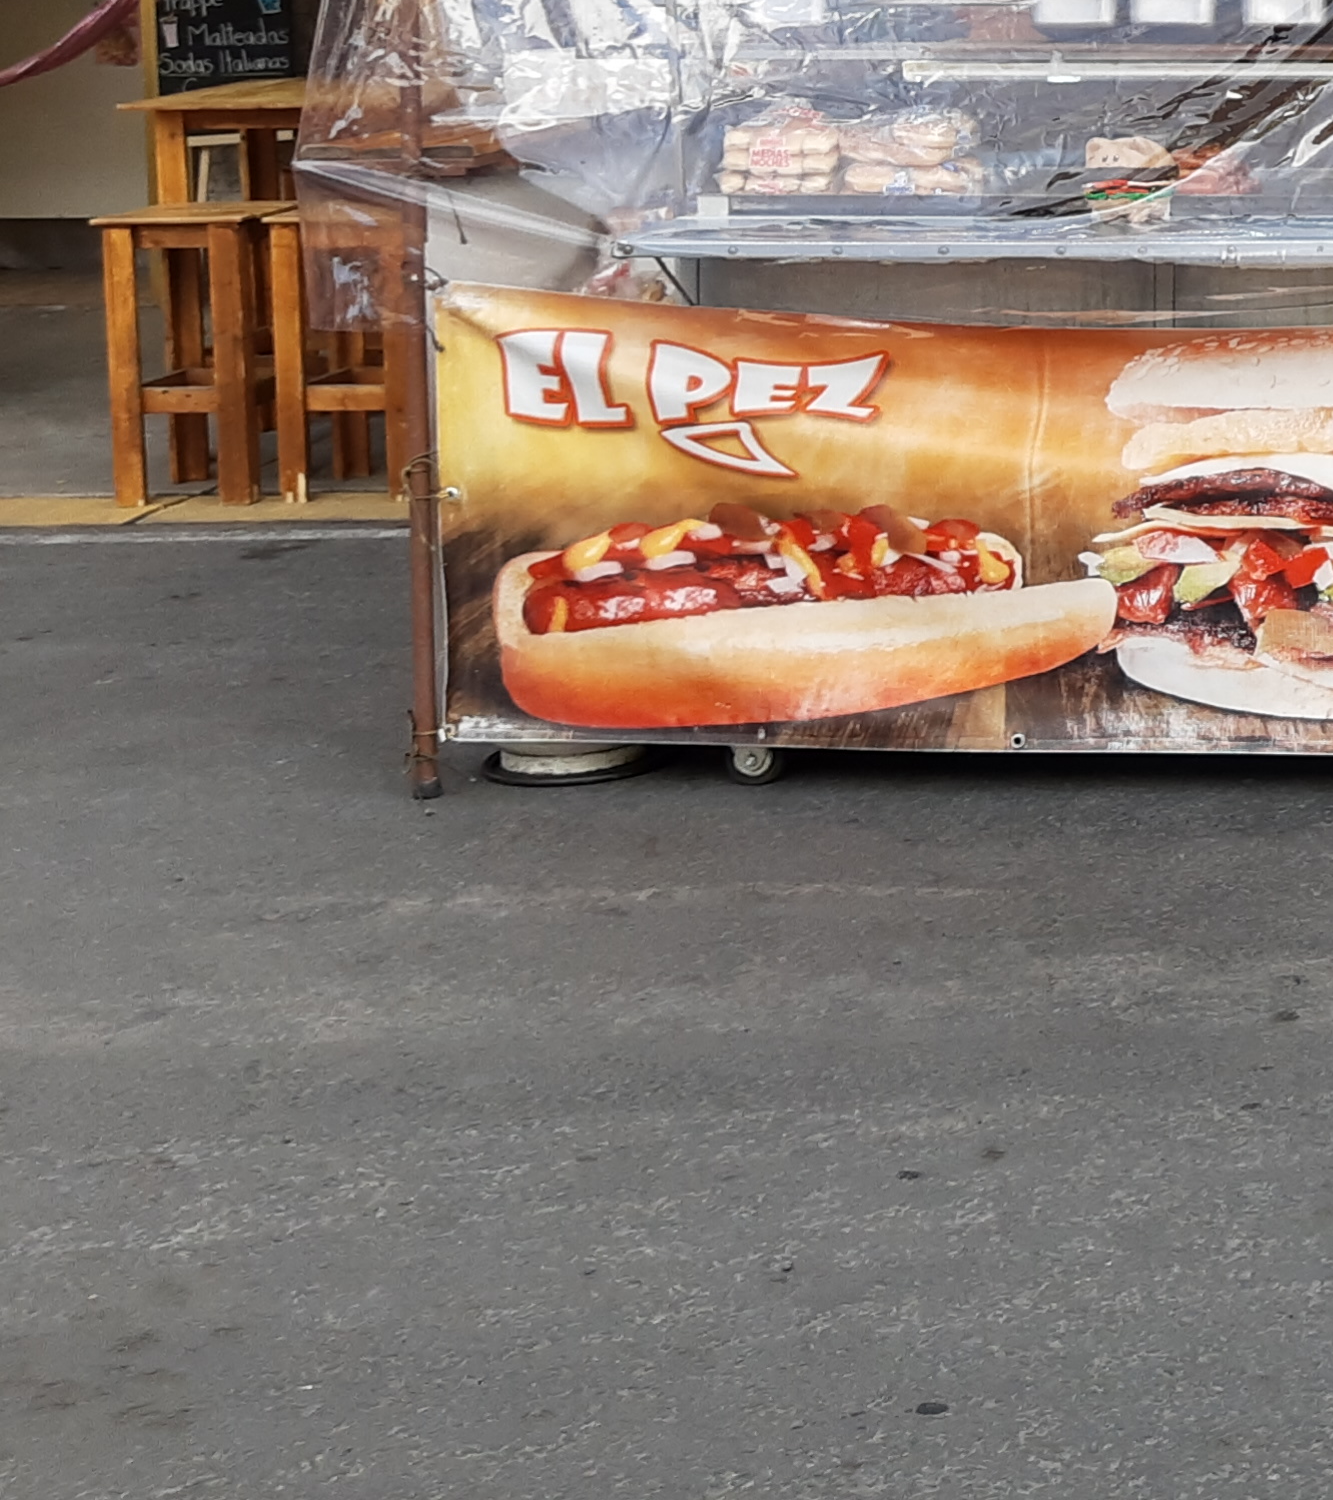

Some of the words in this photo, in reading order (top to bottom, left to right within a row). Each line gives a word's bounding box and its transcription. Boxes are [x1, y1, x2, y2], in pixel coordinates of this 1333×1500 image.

[159, 52, 214, 75] Sodas
[752, 149, 791, 158] MEDIAS
[750, 158, 790, 168] NOCHES
[496, 327, 634, 429] EL
[647, 338, 890, 430] PEZ
